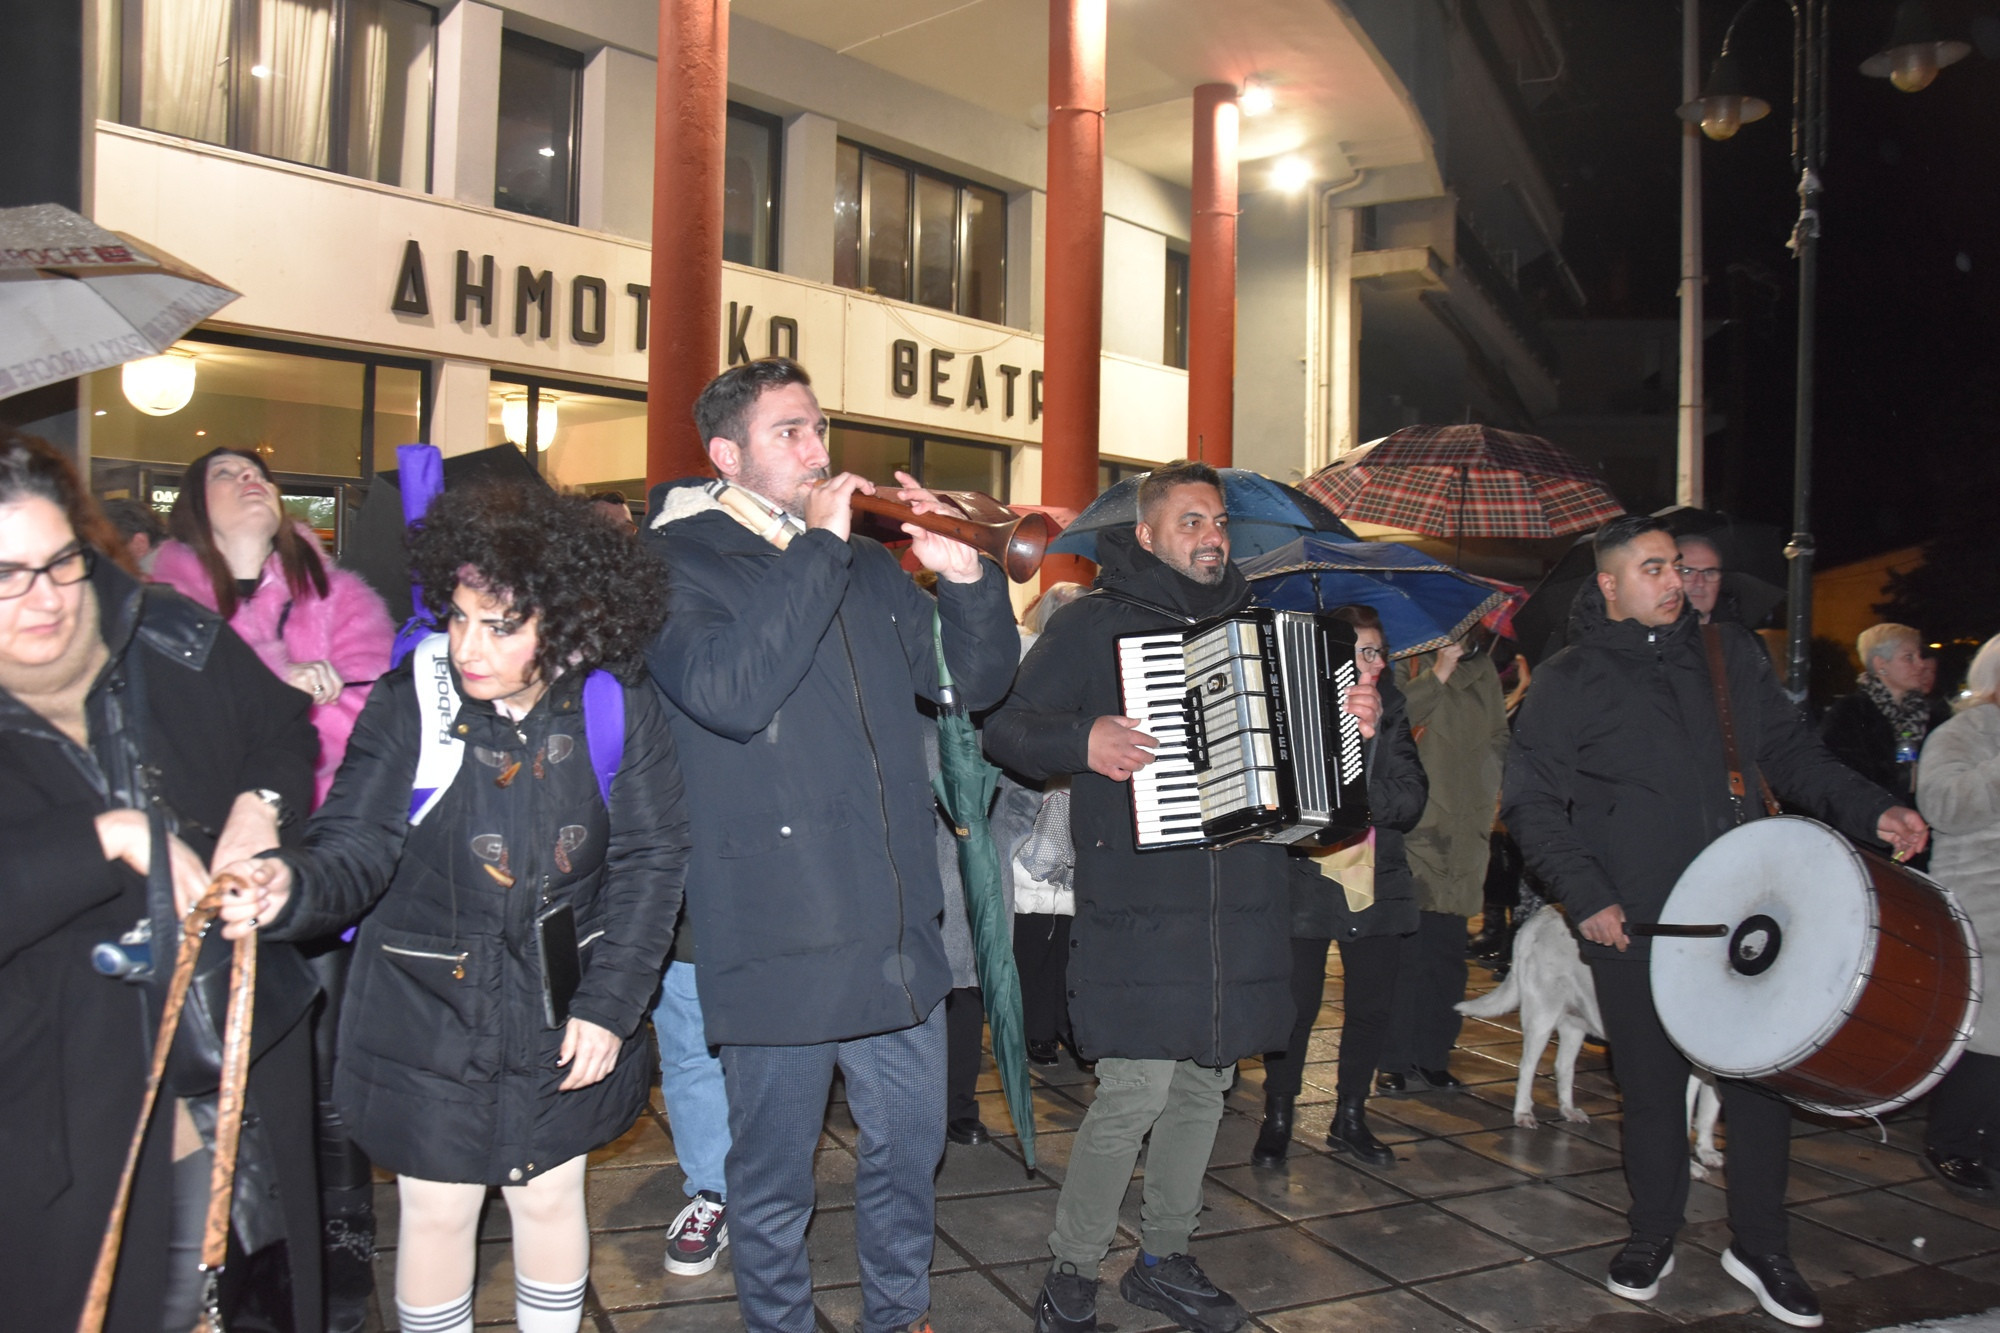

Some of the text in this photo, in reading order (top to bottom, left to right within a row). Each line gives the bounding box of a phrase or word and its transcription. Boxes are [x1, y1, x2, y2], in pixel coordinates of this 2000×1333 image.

[0, 247, 98, 265] ROCHE
[391, 239, 1044, 421] ΔΗΜΟΤΚΟ ΘΕΑΤΡ
[1262, 624, 1288, 760] WELTMEISTER
